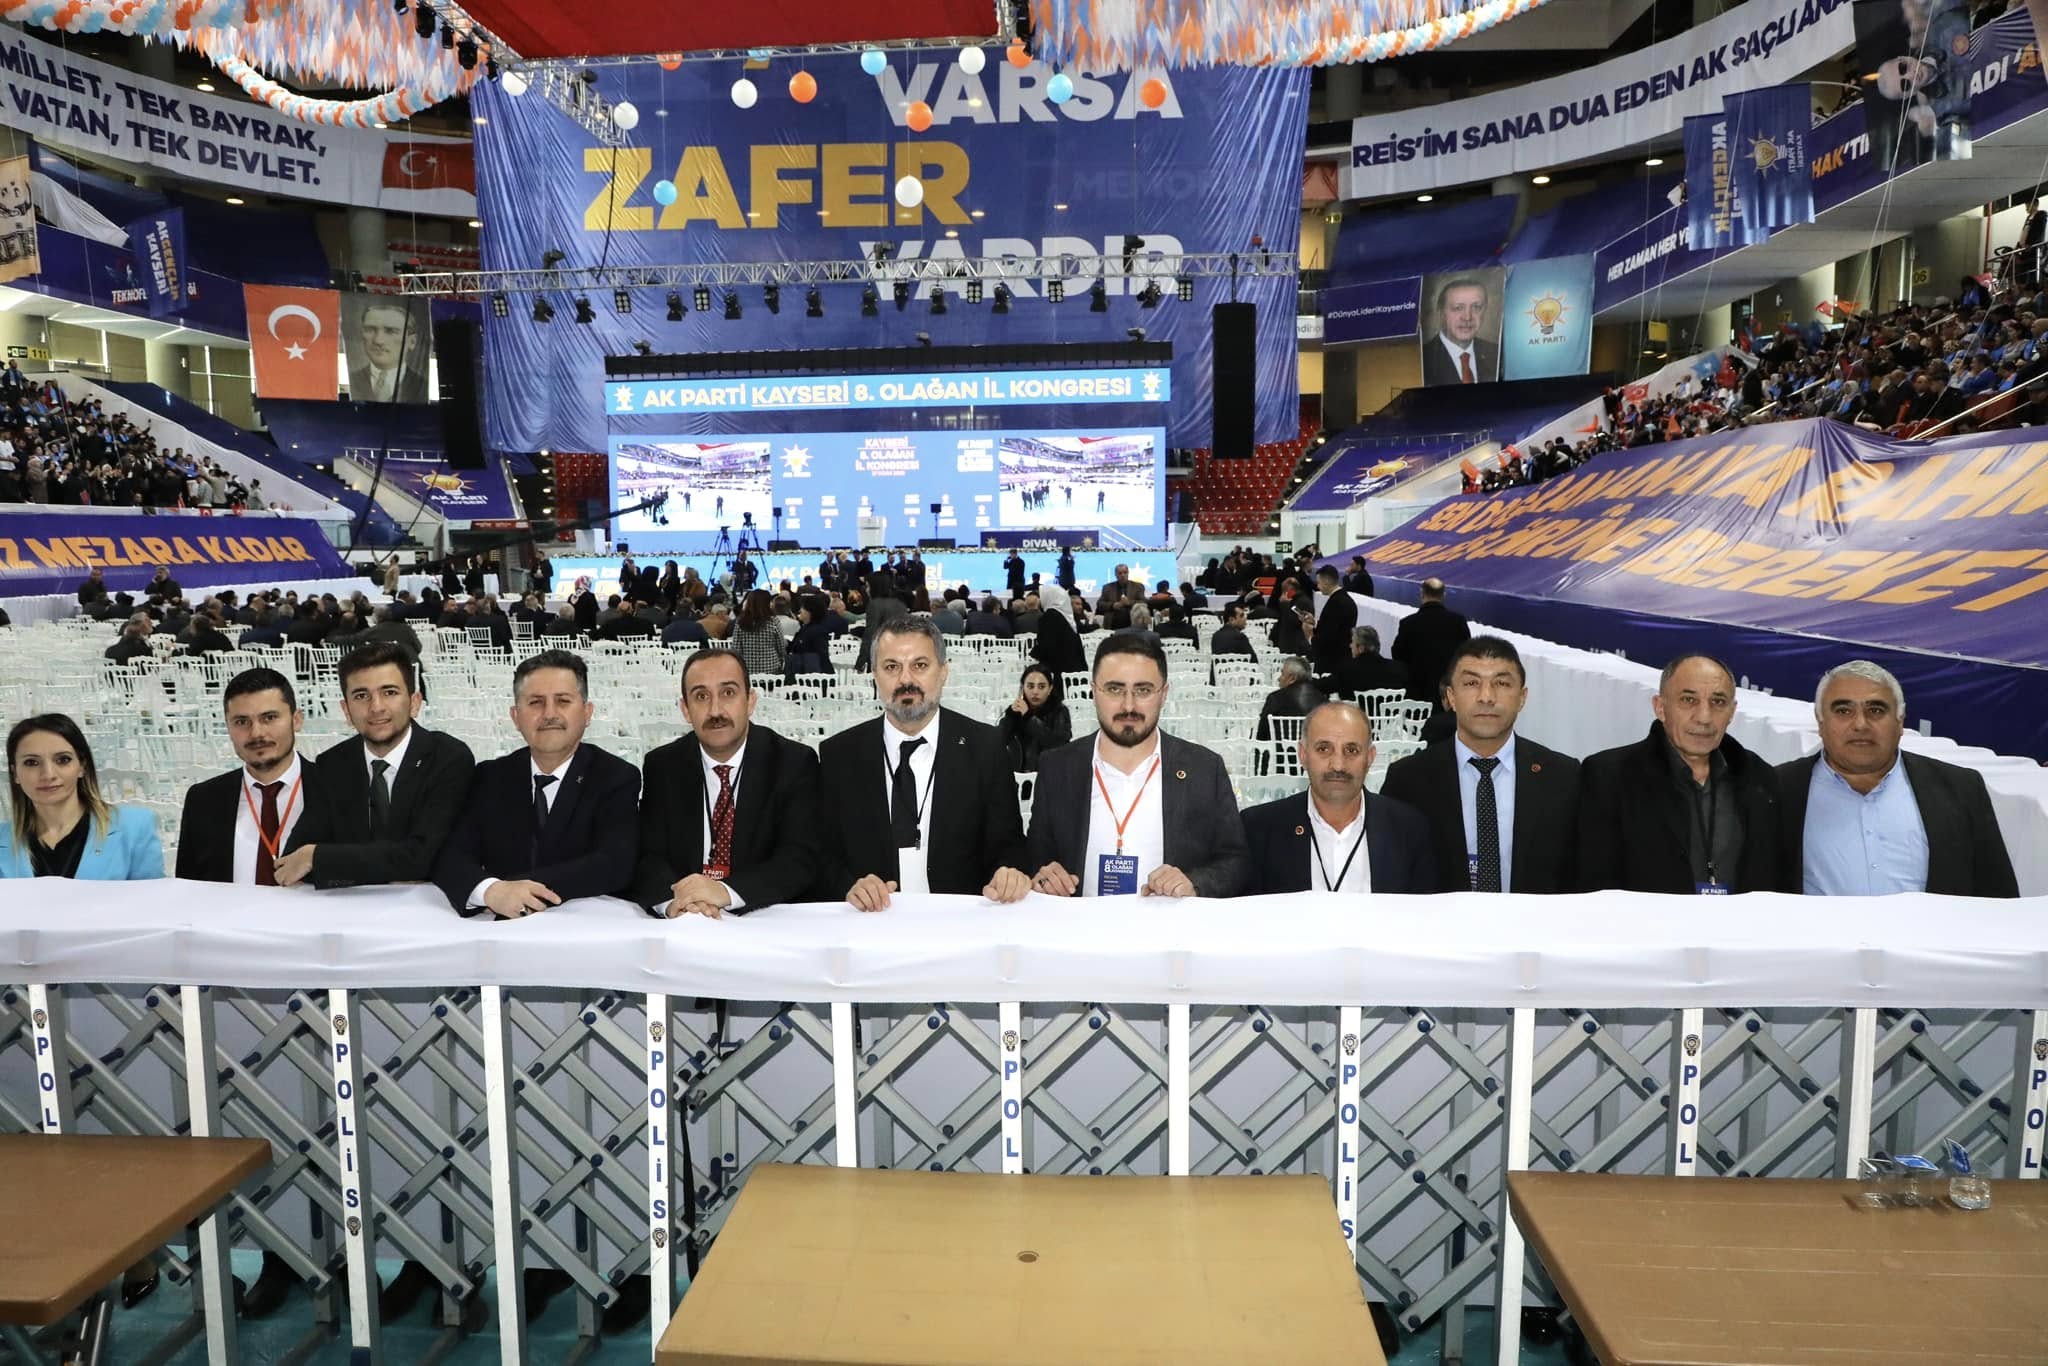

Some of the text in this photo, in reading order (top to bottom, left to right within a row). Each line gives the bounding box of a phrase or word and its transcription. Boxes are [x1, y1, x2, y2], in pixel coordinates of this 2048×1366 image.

[0, 39, 327, 157] MİLLET, TEK BAYRAK,
[877, 57, 1184, 127] VARSA
[1462, 112, 1546, 150] SANA
[1548, 94, 1610, 131] DUA
[1614, 63, 1685, 111] EDEN
[1688, 45, 1728, 87] AK
[1731, 8, 1798, 66] SAÇLI
[1970, 55, 2009, 97] ADI
[8, 83, 321, 186] VATAN, TEK DEVLET.
[583, 140, 976, 231] ZAFER
[859, 233, 1185, 302] VARDIR
[1607, 261, 1625, 282] HER
[1624, 243, 1658, 274] ZAMAN
[1657, 233, 1678, 257] HER
[643, 376, 1132, 407] AK PARTİ KAYSERİ 8. OLAĞAN İL KONGRESİ
[23, 536, 210, 568] MEZARA
[198, 536, 316, 563] KADAR
[36, 1036, 58, 1128] POL
[335, 1043, 359, 1208] POLİS
[1003, 1060, 1020, 1158] POL
[1679, 1064, 1698, 1164] POL
[2024, 1069, 2048, 1169] POL
[650, 1050, 667, 1220] POLİS
[1340, 1064, 1358, 1240] POLİS
